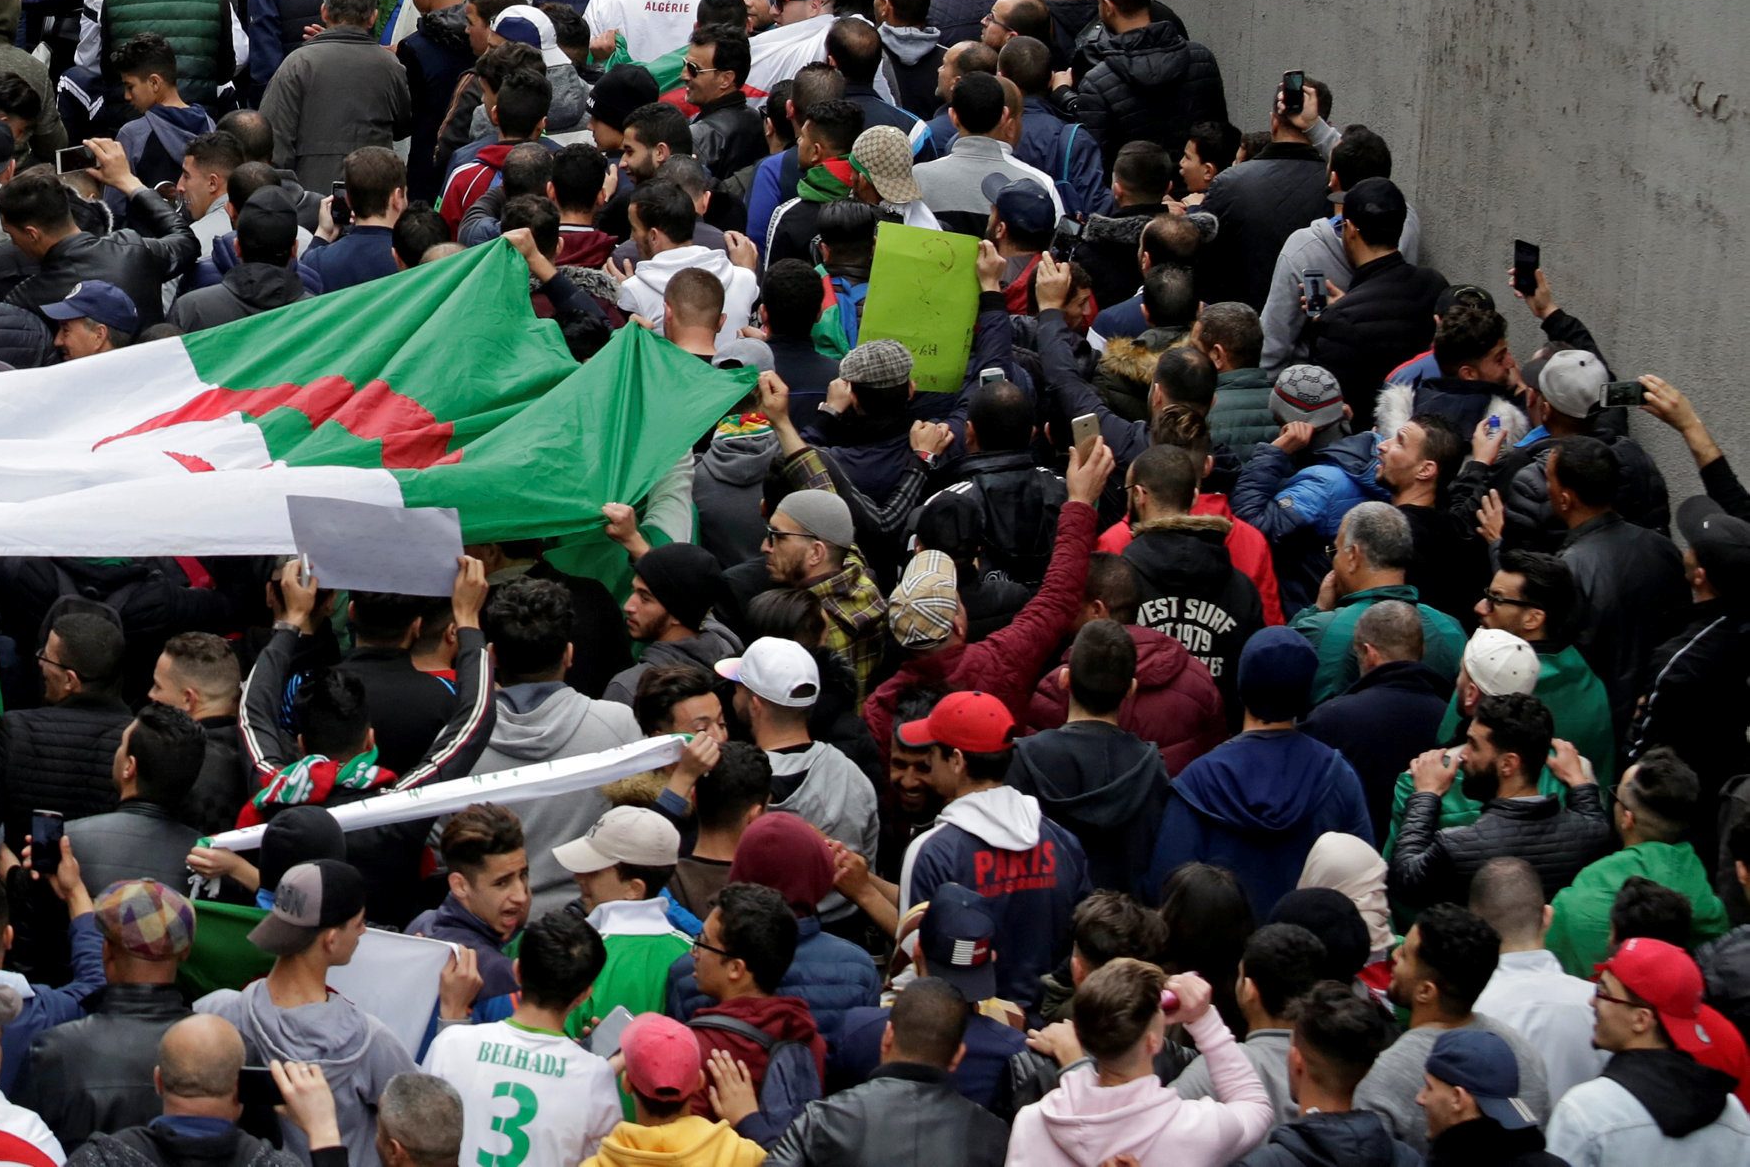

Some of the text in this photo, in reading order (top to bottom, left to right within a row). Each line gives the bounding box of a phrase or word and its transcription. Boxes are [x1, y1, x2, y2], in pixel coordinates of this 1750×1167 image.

[644, 0, 690, 13] ALGÉRIE
[1184, 598, 1237, 634] SURF
[1176, 623, 1212, 652] 1979
[477, 1041, 568, 1078] BELHADJ
[476, 1081, 539, 1167] 3
